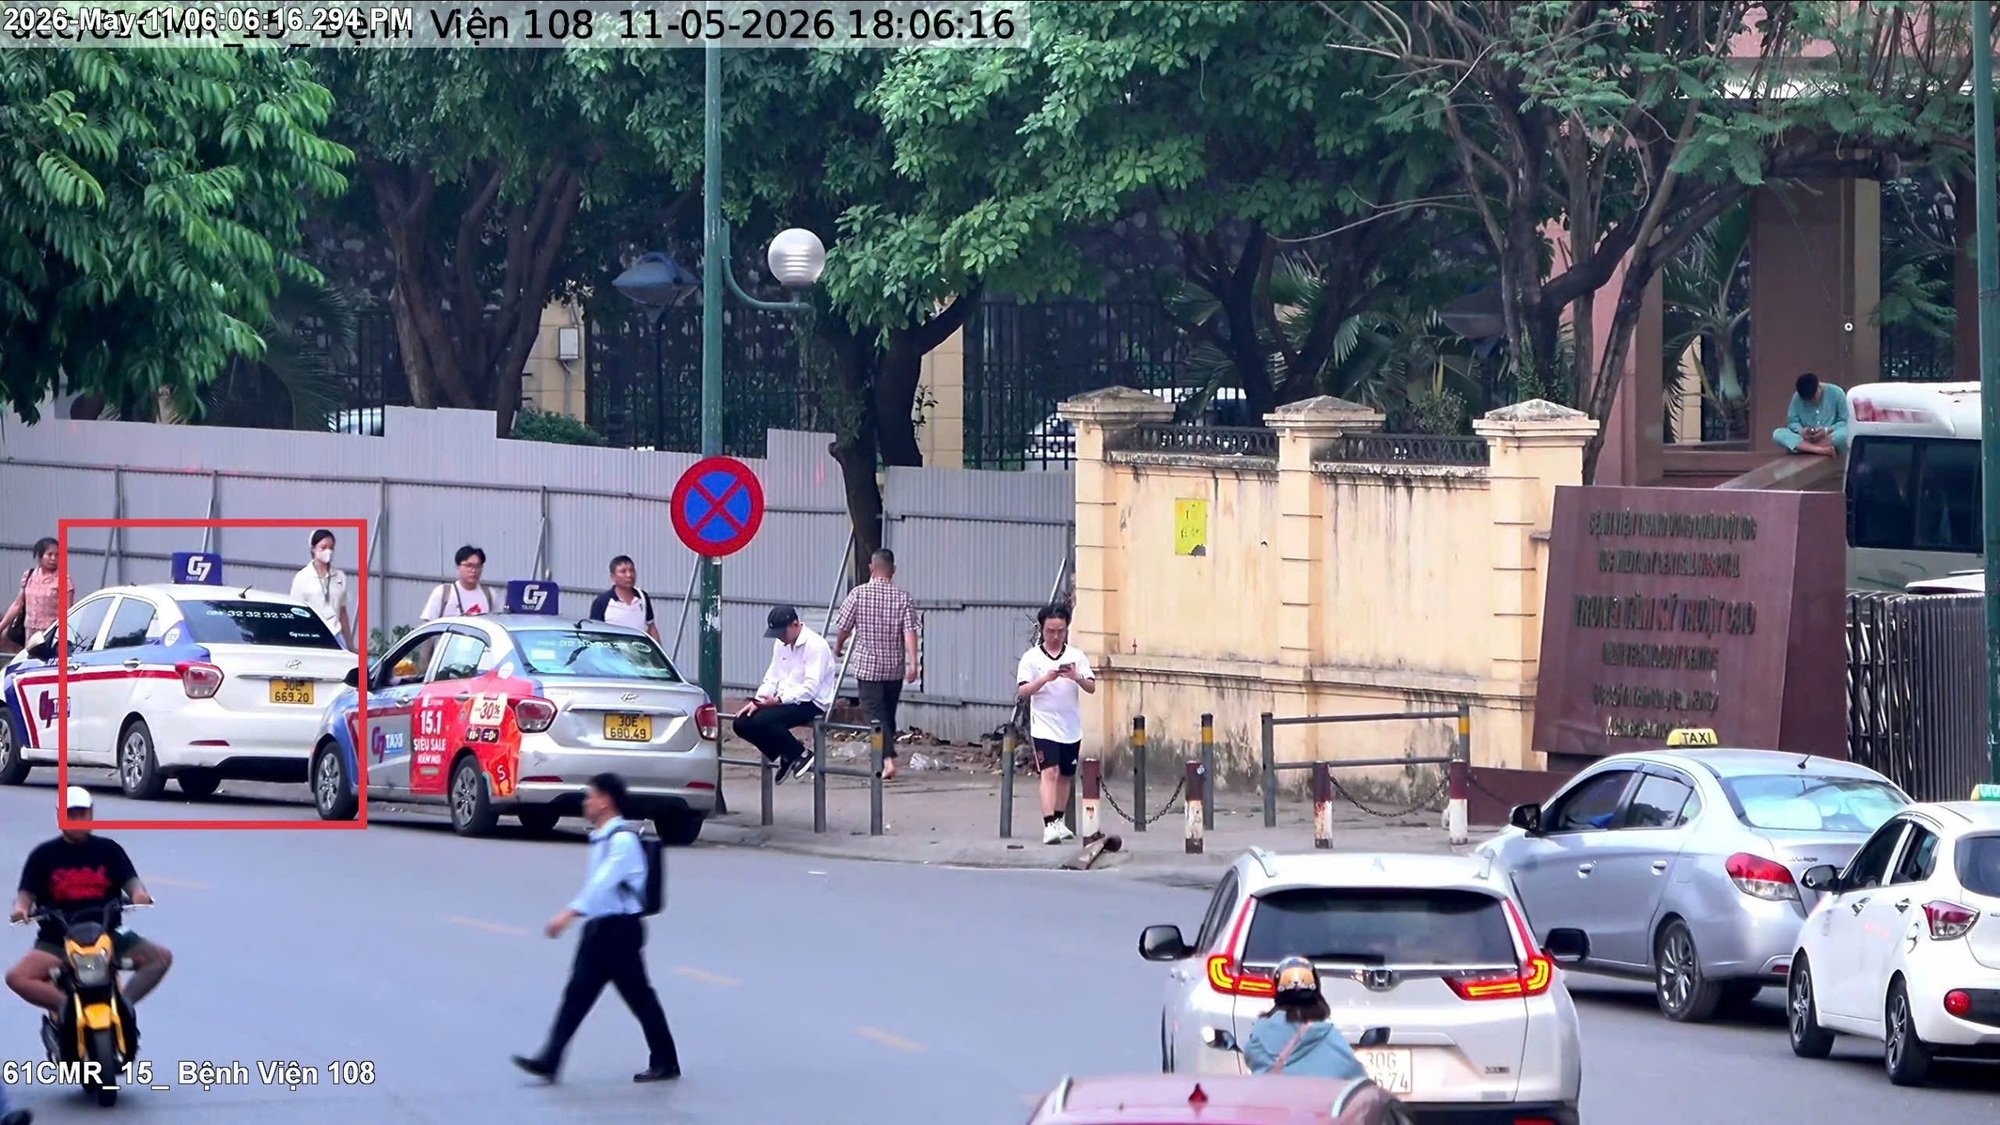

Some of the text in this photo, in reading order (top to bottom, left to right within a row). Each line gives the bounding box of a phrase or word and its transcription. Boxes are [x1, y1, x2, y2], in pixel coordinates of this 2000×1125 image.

[275, 693, 309, 703] 669.20
[420, 711, 442, 735] 15.1
[619, 716, 638, 727] 30E
[610, 728, 647, 739] 680.49
[1682, 732, 1712, 744] TAXI
[385, 733, 404, 749] TAXI
[431, 738, 446, 752] SALE
